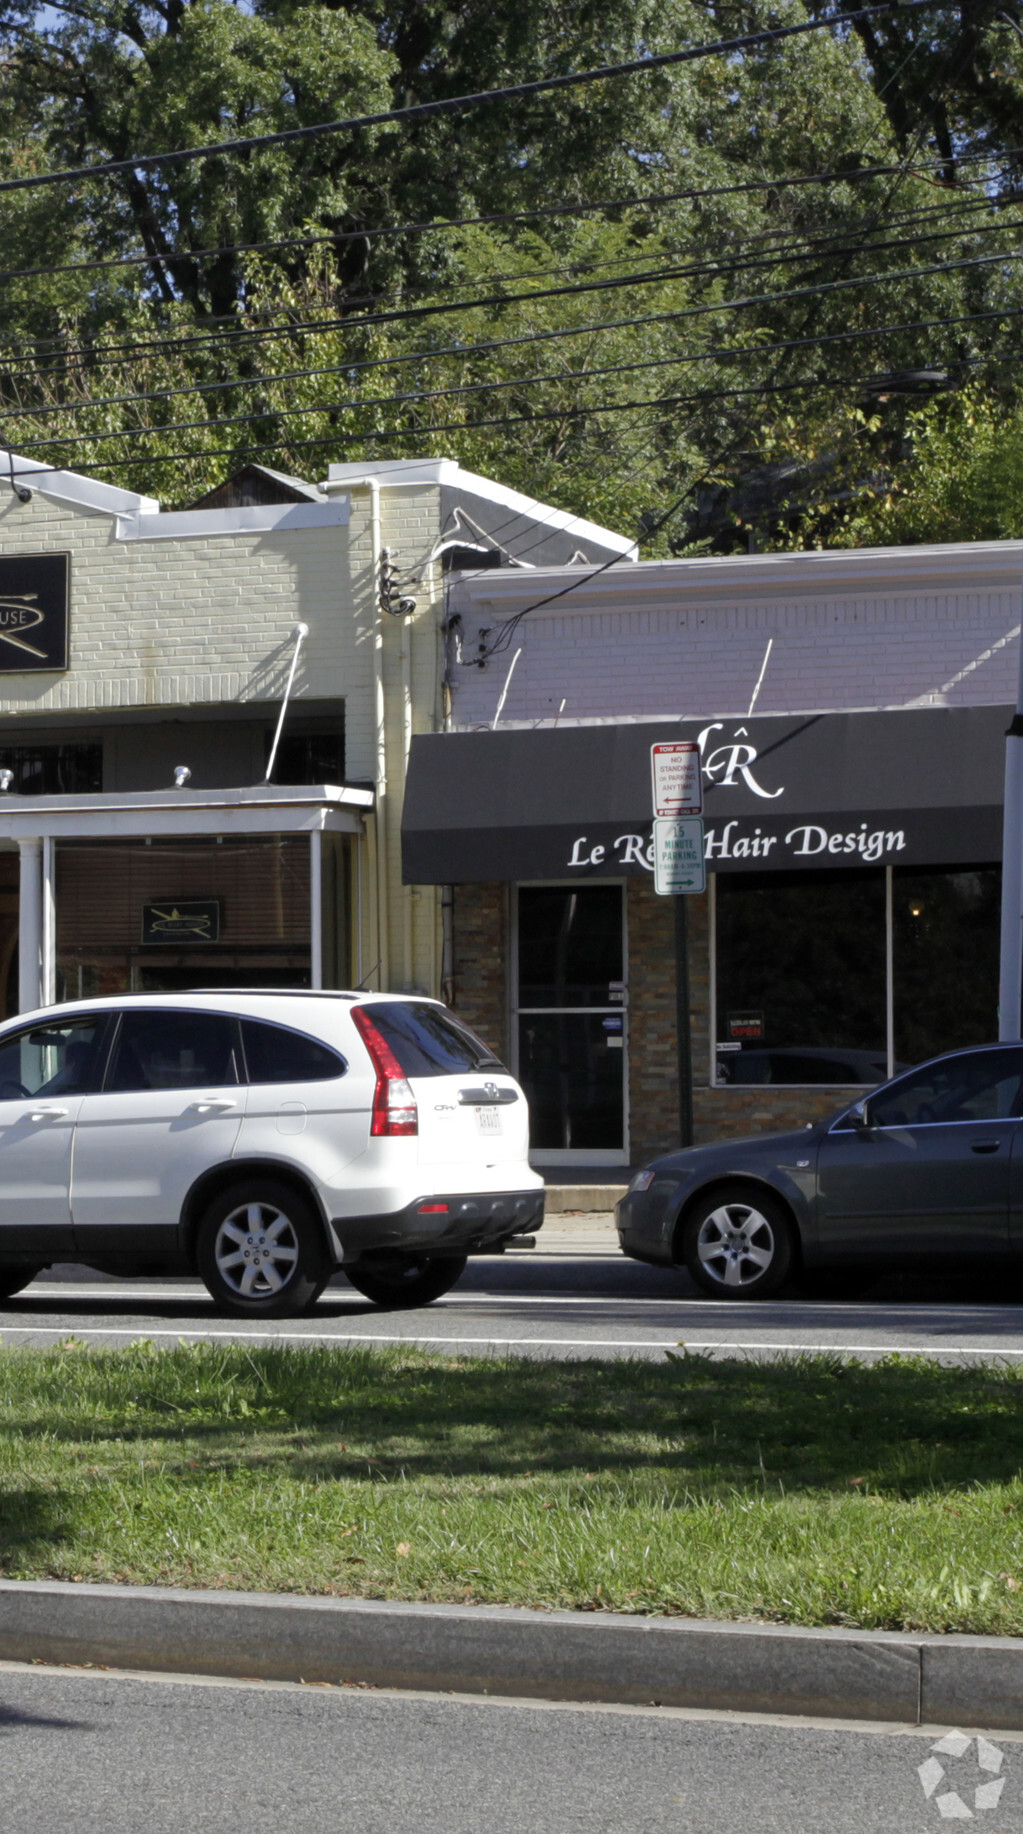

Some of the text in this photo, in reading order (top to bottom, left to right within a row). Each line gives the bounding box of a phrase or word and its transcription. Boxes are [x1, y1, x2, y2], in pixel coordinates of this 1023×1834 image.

[660, 765, 695, 773] STANDING
[673, 826, 685, 838] 15
[567, 836, 605, 867] Le
[703, 820, 777, 859] Hair
[785, 823, 906, 862] Design
[665, 839, 694, 849] MINUTE
[662, 851, 698, 860] PARKING
[730, 1027, 761, 1037] OPEN
